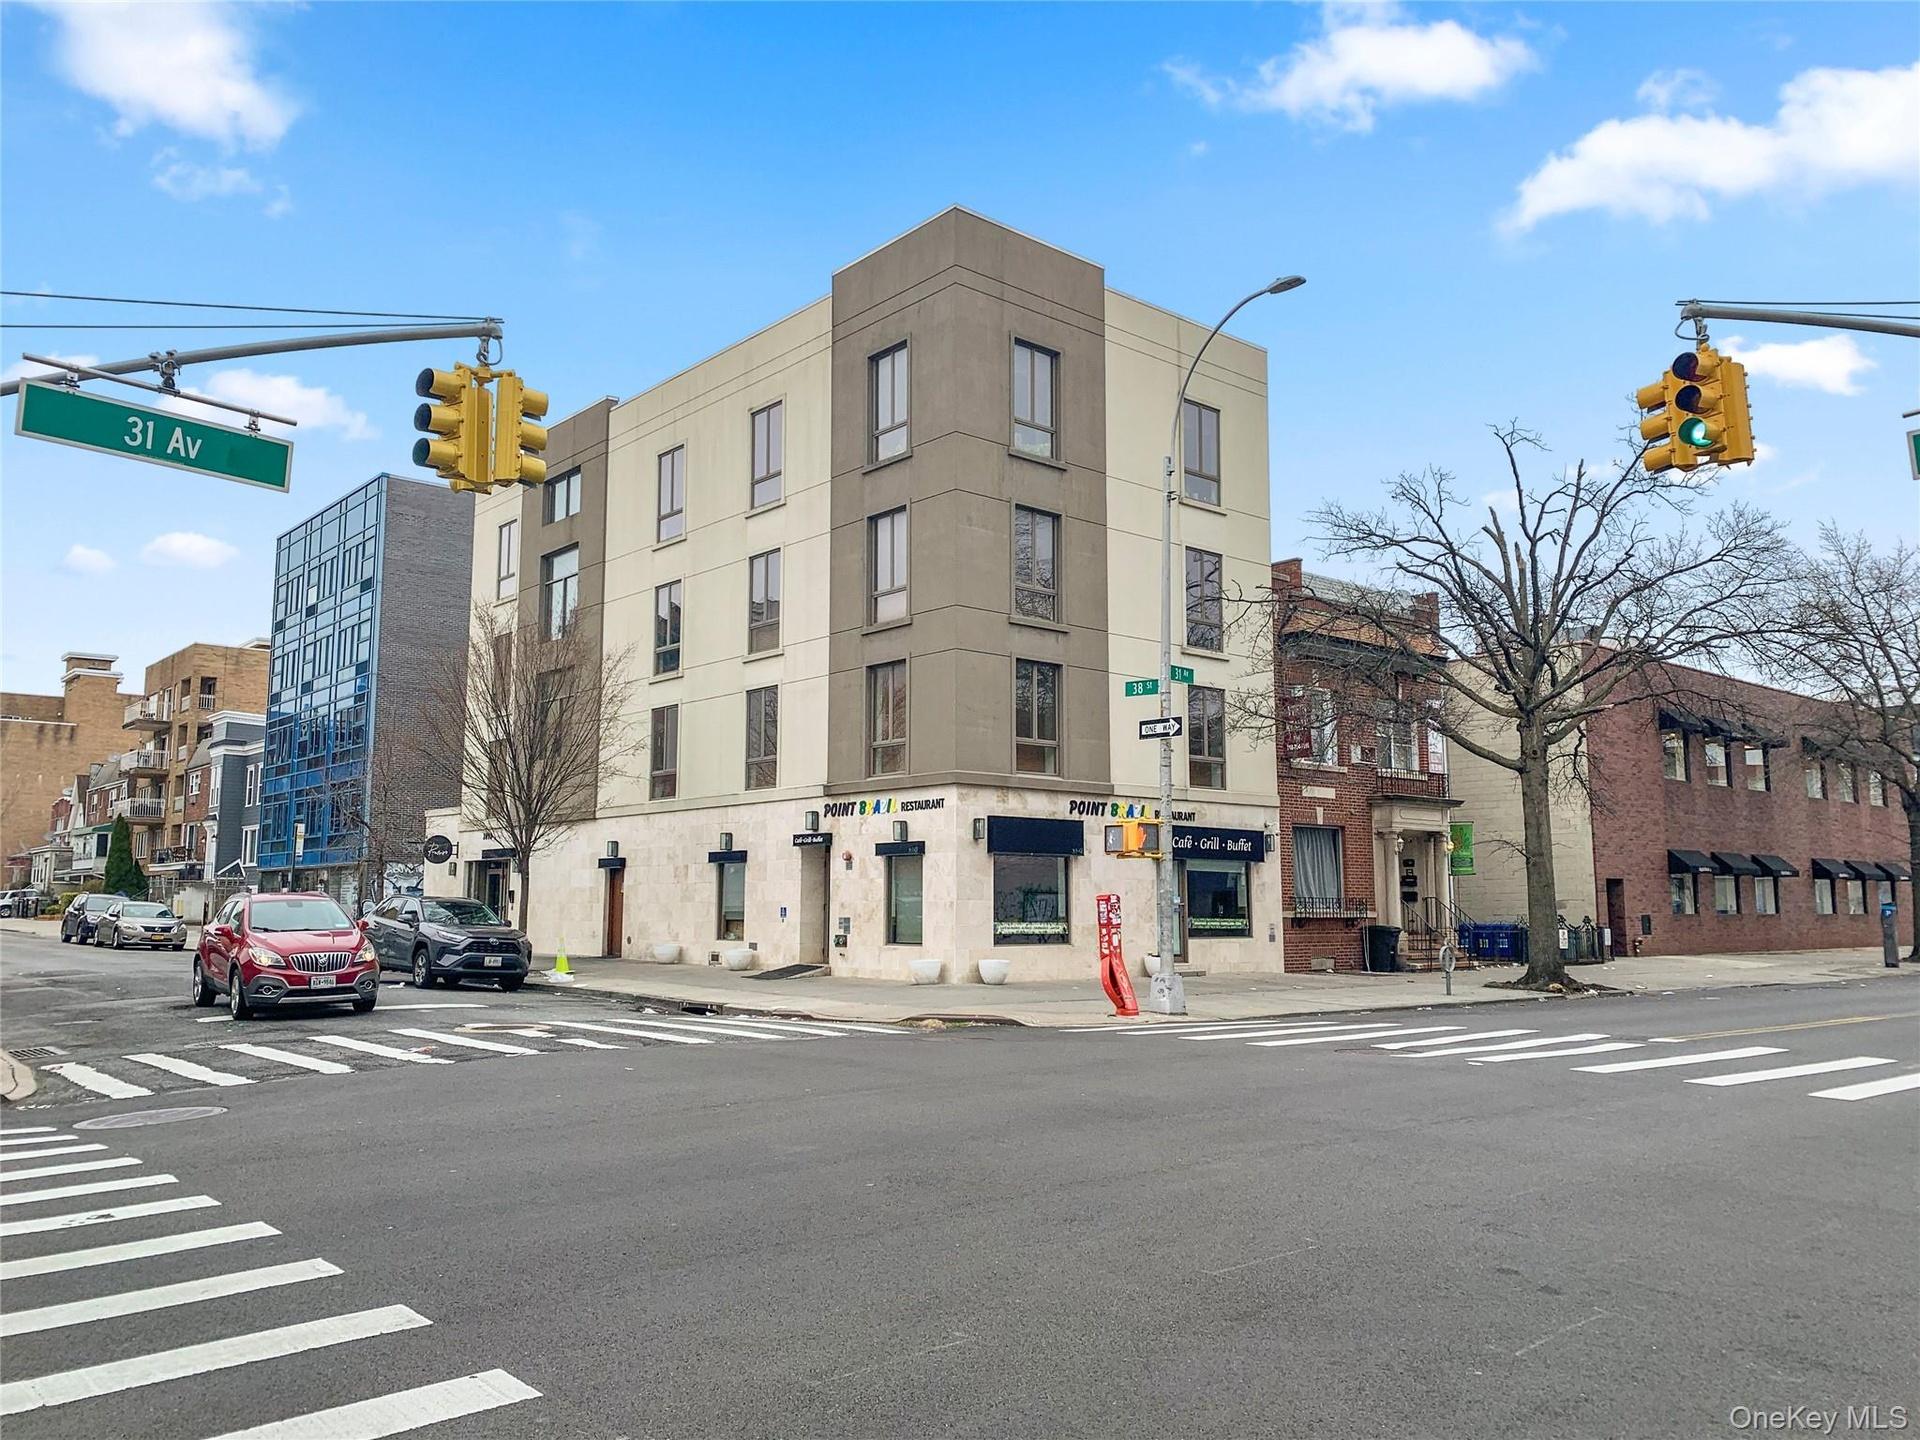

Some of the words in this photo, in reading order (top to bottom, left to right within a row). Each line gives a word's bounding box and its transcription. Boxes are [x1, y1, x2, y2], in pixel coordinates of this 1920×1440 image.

[124, 416, 154, 450] 31
[166, 427, 202, 459] Av
[1175, 667, 1182, 680] 31
[1132, 682, 1143, 695] 38
[1144, 725, 1157, 734] ONE
[1162, 723, 1176, 732] WAY
[823, 802, 857, 818] POINT
[859, 796, 898, 817] BRAZIL
[901, 798, 945, 812] RESTAURANT
[1069, 800, 1108, 817] POINT
[1110, 801, 1152, 820] BRAZIL
[1154, 809, 1196, 822] RURANT
[1172, 835, 1193, 848] Café
[1200, 836, 1220, 850] Grill
[1227, 838, 1252, 852] Buffet
